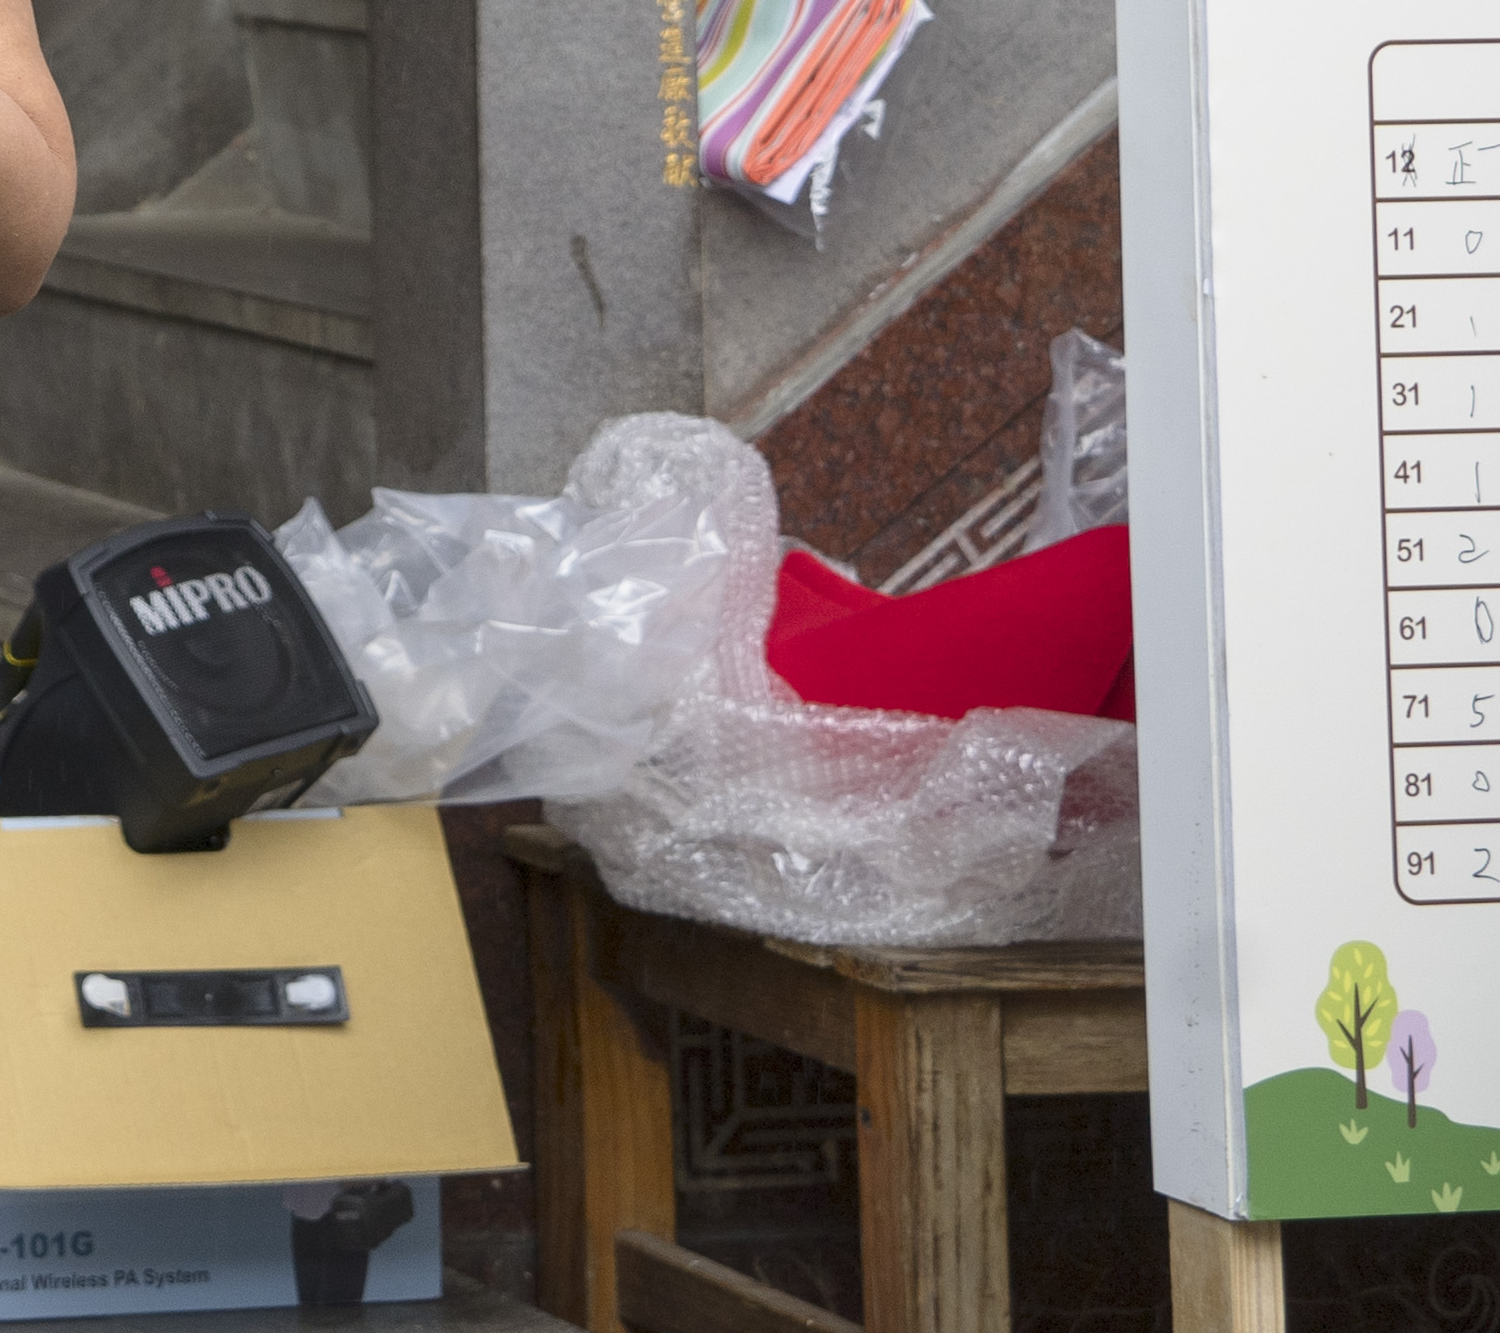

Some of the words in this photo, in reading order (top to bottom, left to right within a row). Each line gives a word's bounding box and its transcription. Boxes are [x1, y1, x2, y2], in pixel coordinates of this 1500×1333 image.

[1386, 227, 1417, 253] 11
[1389, 304, 1419, 330] 21
[1391, 382, 1421, 408] 31
[1393, 460, 1423, 486] 41
[1396, 538, 1426, 564] 51
[1457, 533, 1491, 565] 2
[127, 562, 273, 637] MIPRO
[1398, 615, 1428, 641] 61
[1402, 693, 1431, 720] 71
[1469, 693, 1497, 729] 5
[1404, 771, 1434, 797] 81
[1407, 850, 1437, 877] 91
[29, 1269, 109, 1292] Wireless
[112, 1267, 140, 1289] PA
[142, 1266, 211, 1290] System
